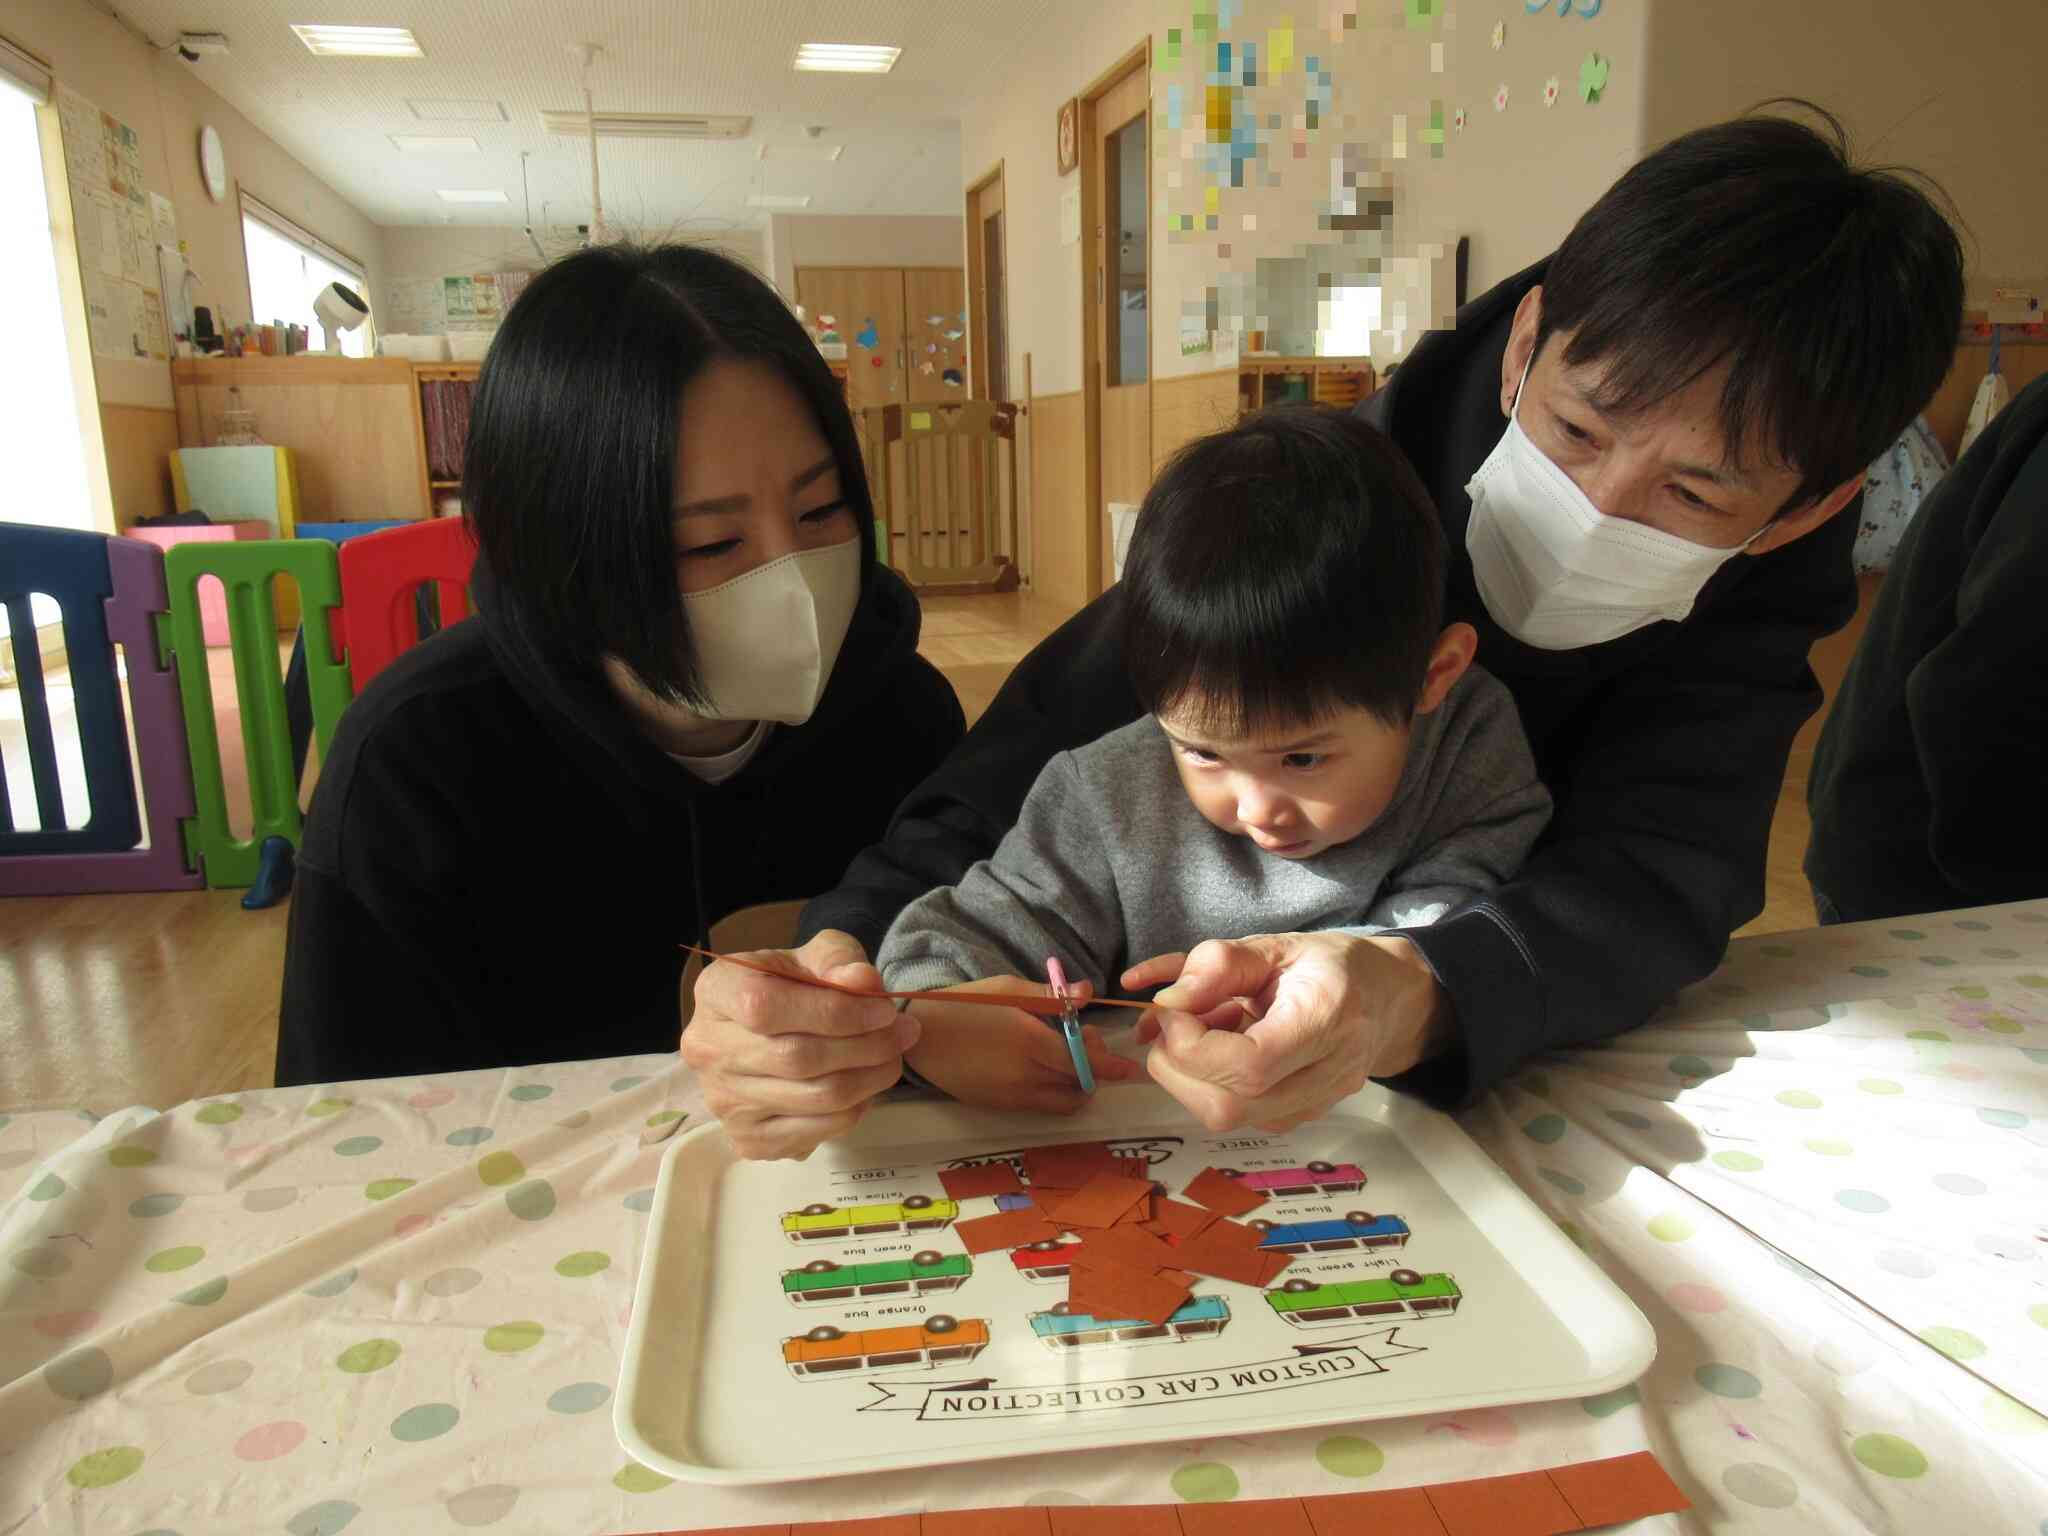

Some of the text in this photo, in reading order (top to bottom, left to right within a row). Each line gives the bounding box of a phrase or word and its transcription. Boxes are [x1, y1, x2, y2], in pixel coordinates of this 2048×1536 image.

[1216, 1139, 1270, 1150] SINCE
[851, 1169, 897, 1182] 1960
[836, 1191, 905, 1203] Yellow bus
[1275, 1204, 1334, 1216] Blue bus
[843, 1243, 912, 1257] Green bus
[1287, 1257, 1402, 1275] Light green bus
[844, 1304, 927, 1320] Orange bus
[942, 1355, 1356, 1413] CUSTOM CAR COLLECTION
